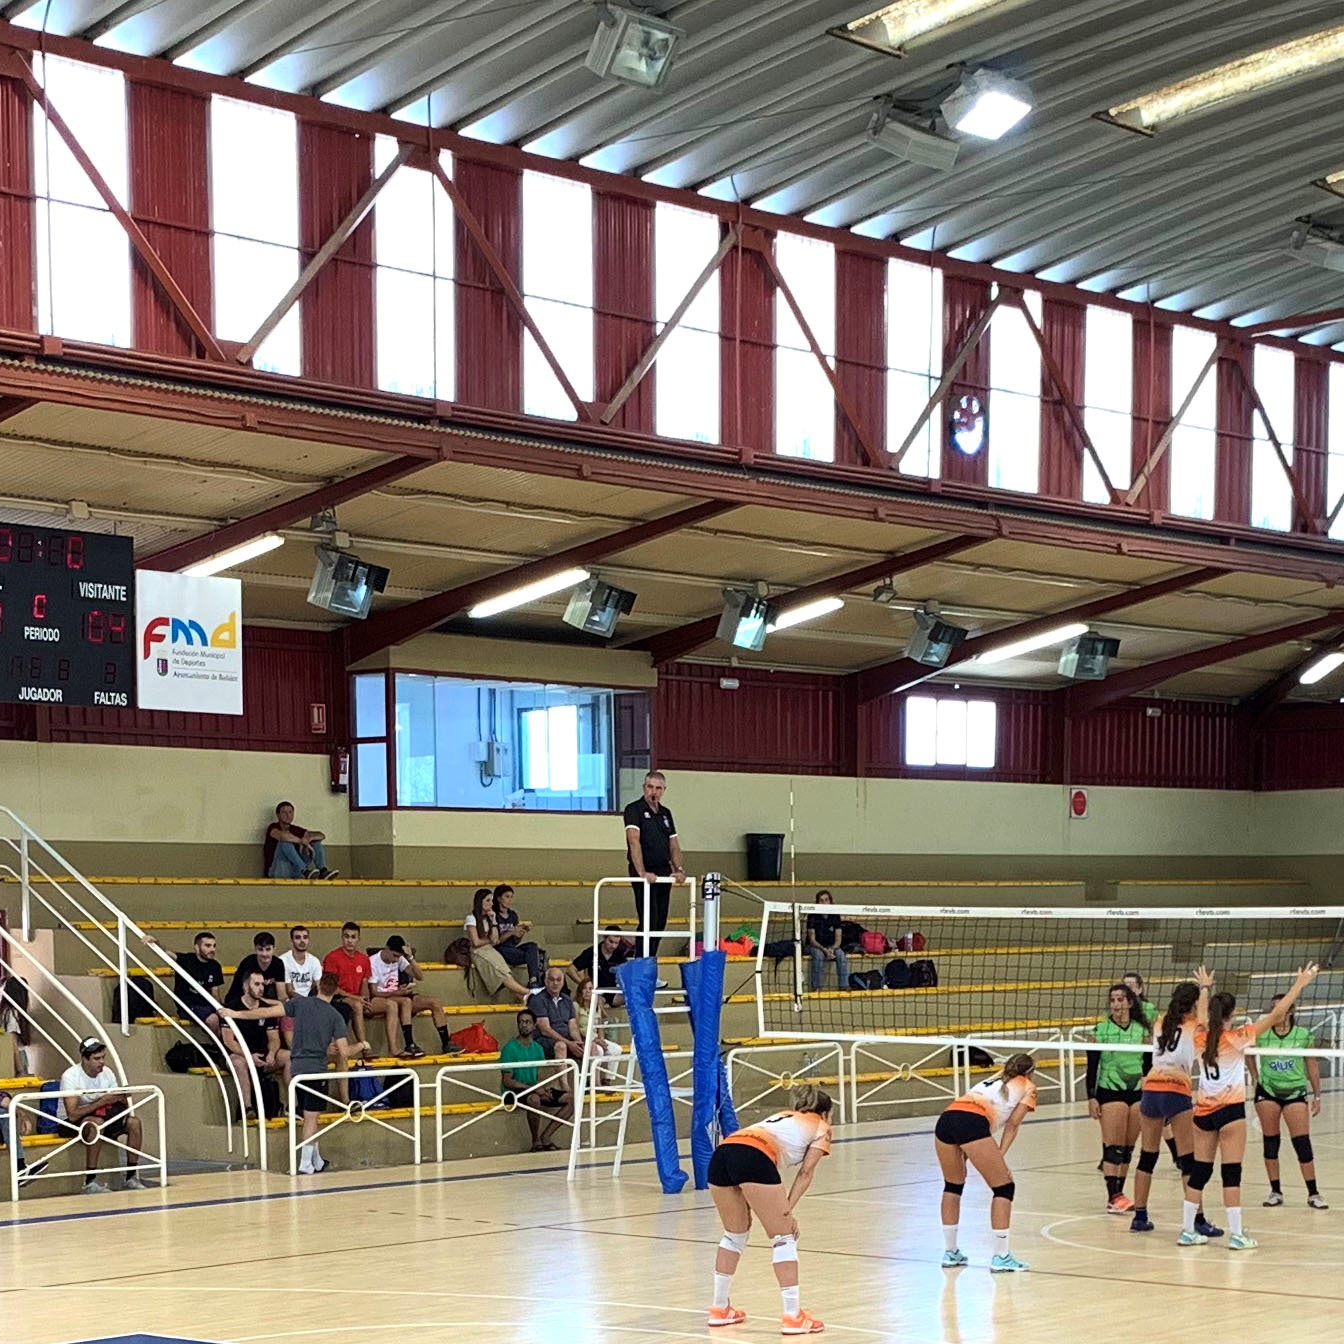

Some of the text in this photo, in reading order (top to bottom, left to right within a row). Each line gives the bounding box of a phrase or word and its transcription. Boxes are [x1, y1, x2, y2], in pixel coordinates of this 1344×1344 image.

[79, 581, 127, 601] VISITANTE
[24, 626, 60, 642] PERIODO
[18, 686, 63, 702] JUGADOR
[94, 691, 128, 706] FALTAS
